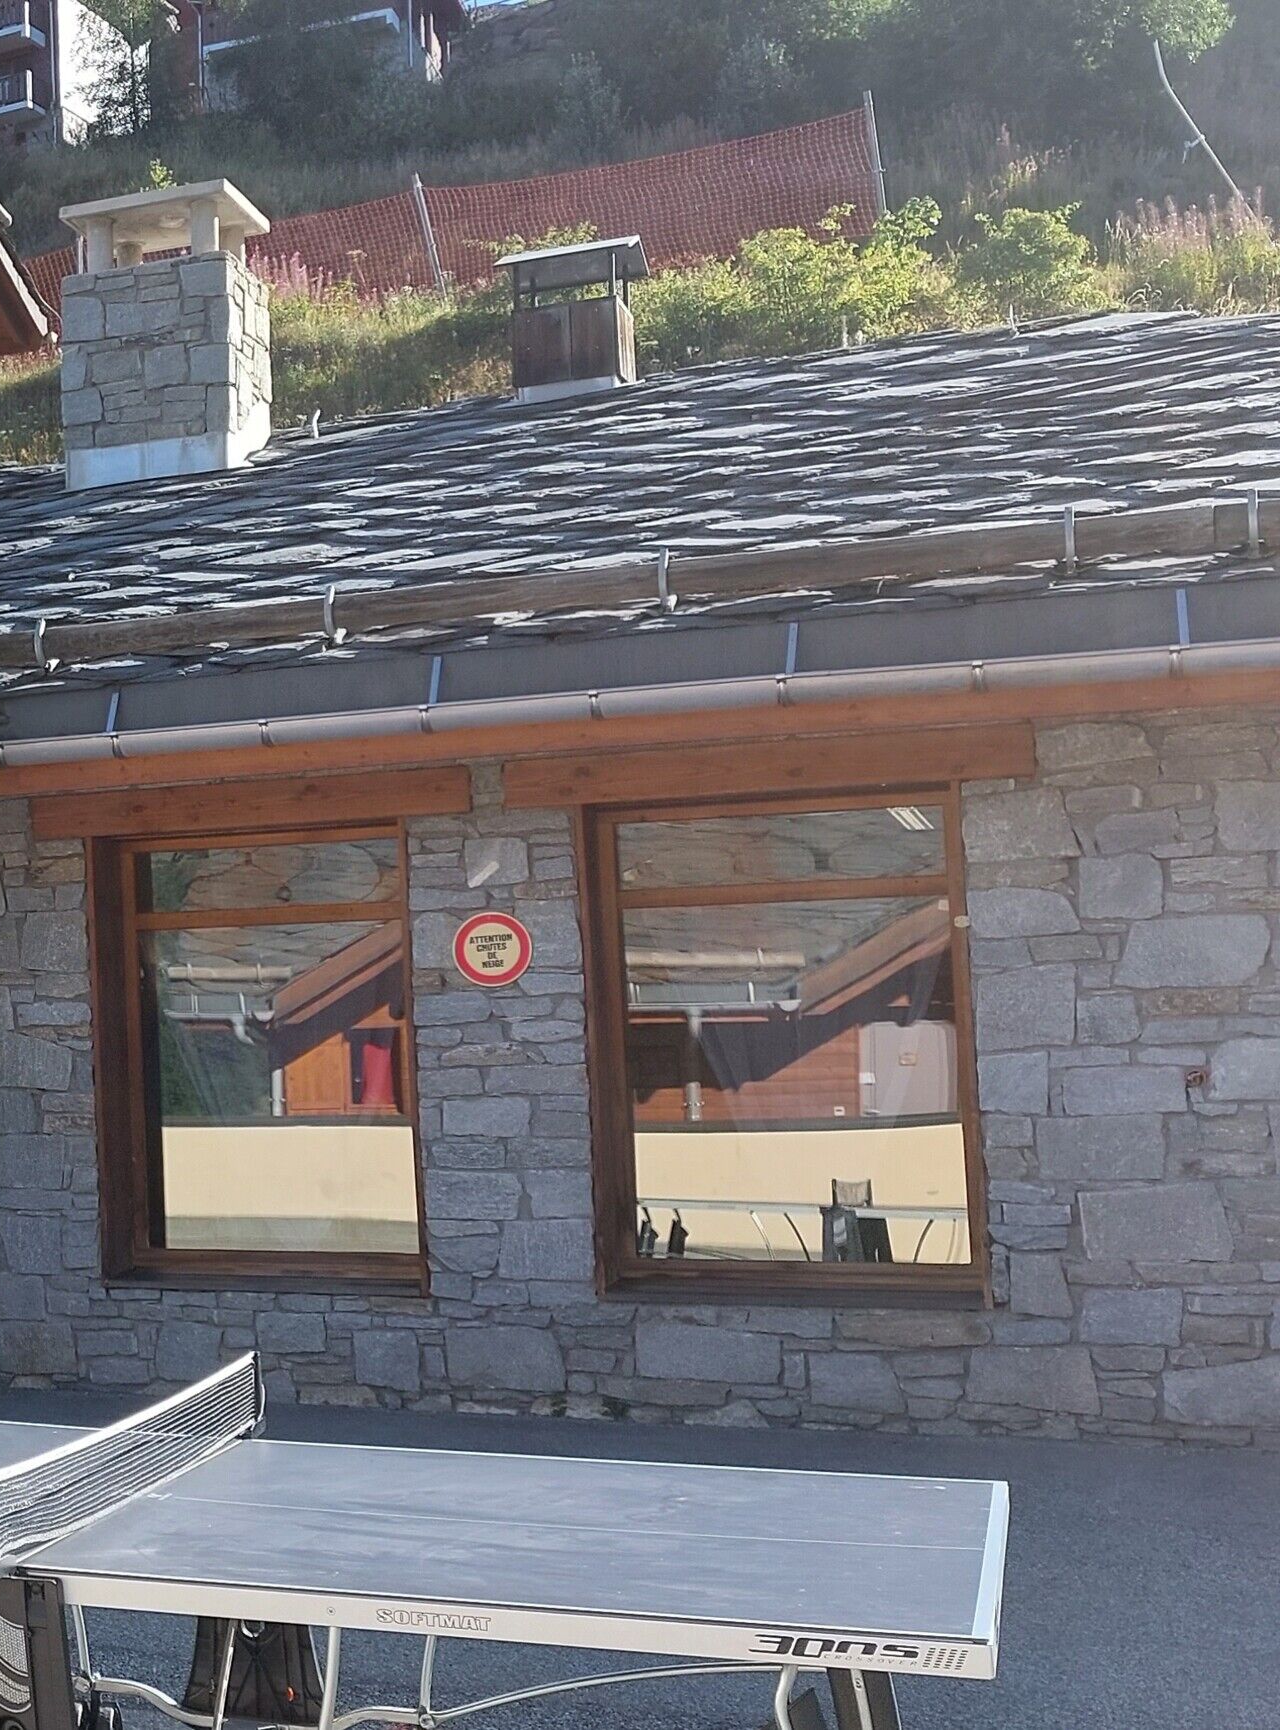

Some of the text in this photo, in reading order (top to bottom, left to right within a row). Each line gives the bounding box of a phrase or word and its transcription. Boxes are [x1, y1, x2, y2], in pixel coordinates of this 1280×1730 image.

[469, 933, 513, 945] ATTENTION
[476, 942, 507, 953] CHUTES
[487, 951, 498, 960] DE
[481, 959, 504, 969] NEIGE
[376, 1609, 491, 1631] SOFTMAT
[823, 1653, 918, 1667] CROSSOVER
